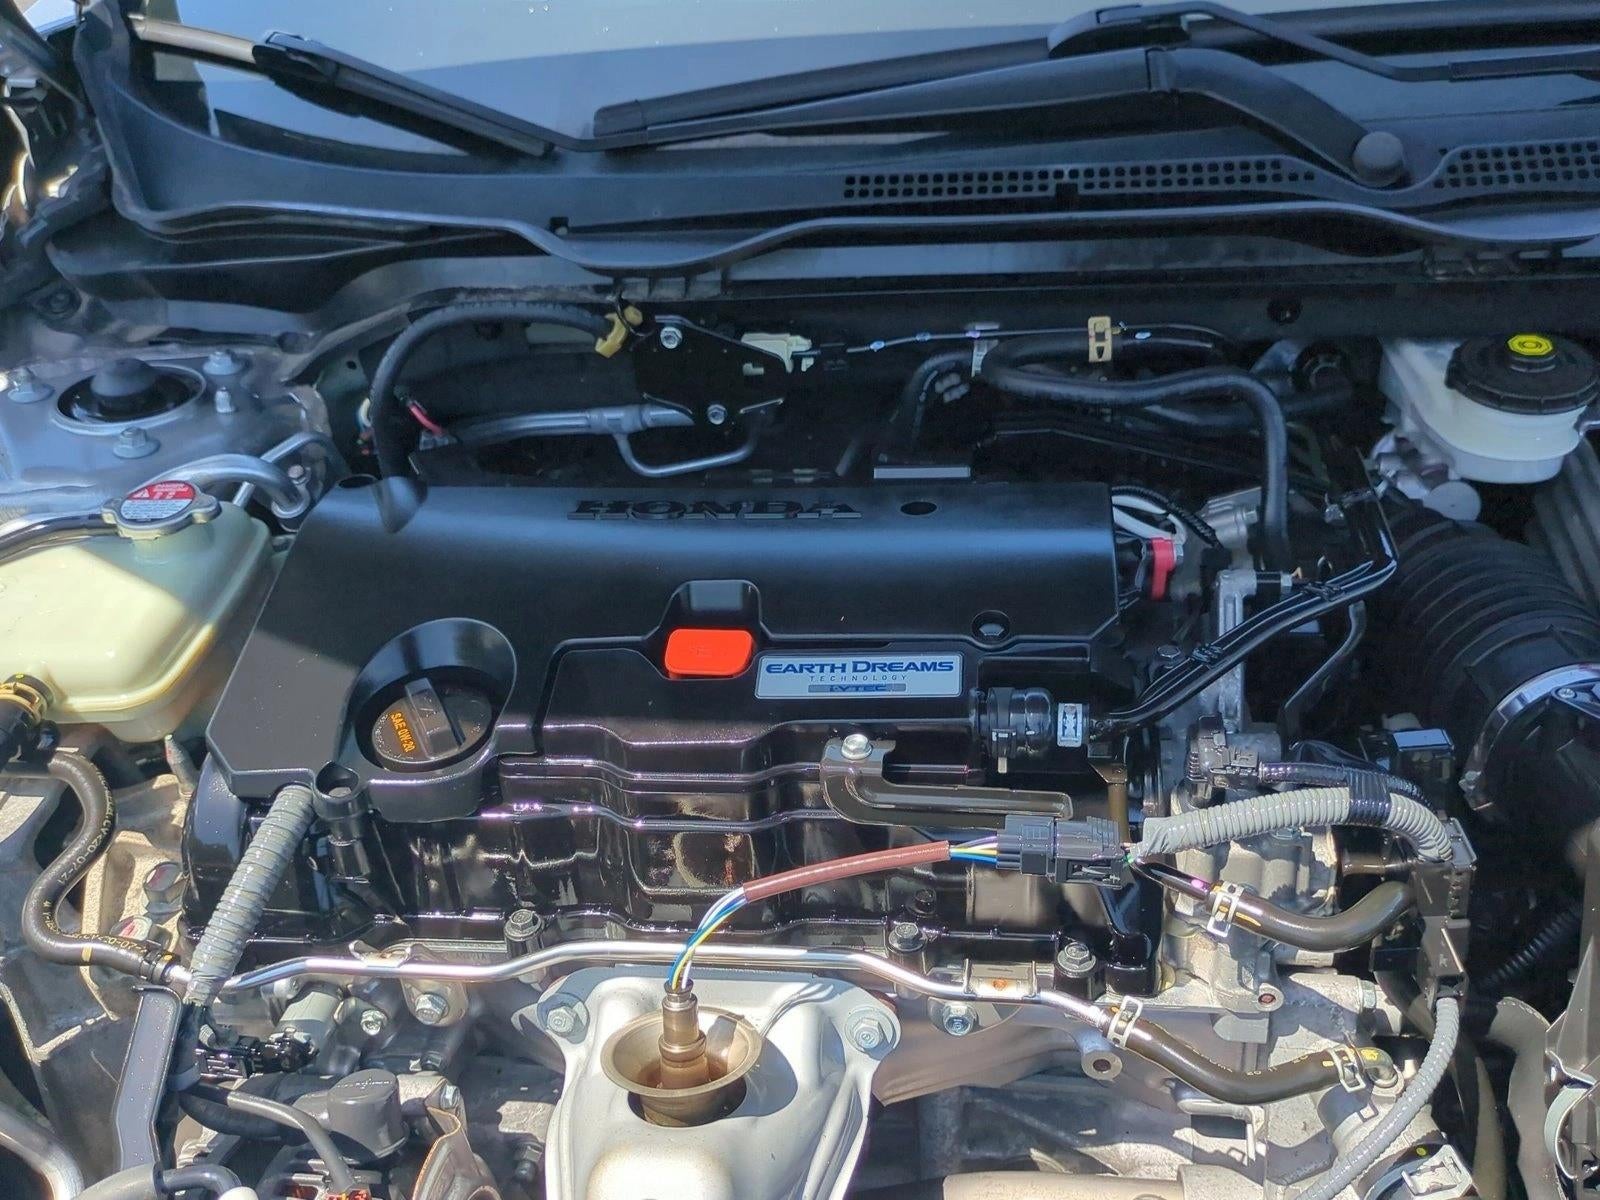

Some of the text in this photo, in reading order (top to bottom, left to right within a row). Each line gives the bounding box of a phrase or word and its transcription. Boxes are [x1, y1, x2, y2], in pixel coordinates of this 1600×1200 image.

[567, 499, 861, 520] HONDA
[765, 660, 955, 674] EARTH DREAMS
[809, 674, 907, 682] TECHNOLOGY
[390, 712, 408, 731] SAE
[397, 728, 416, 753] 0W-20
